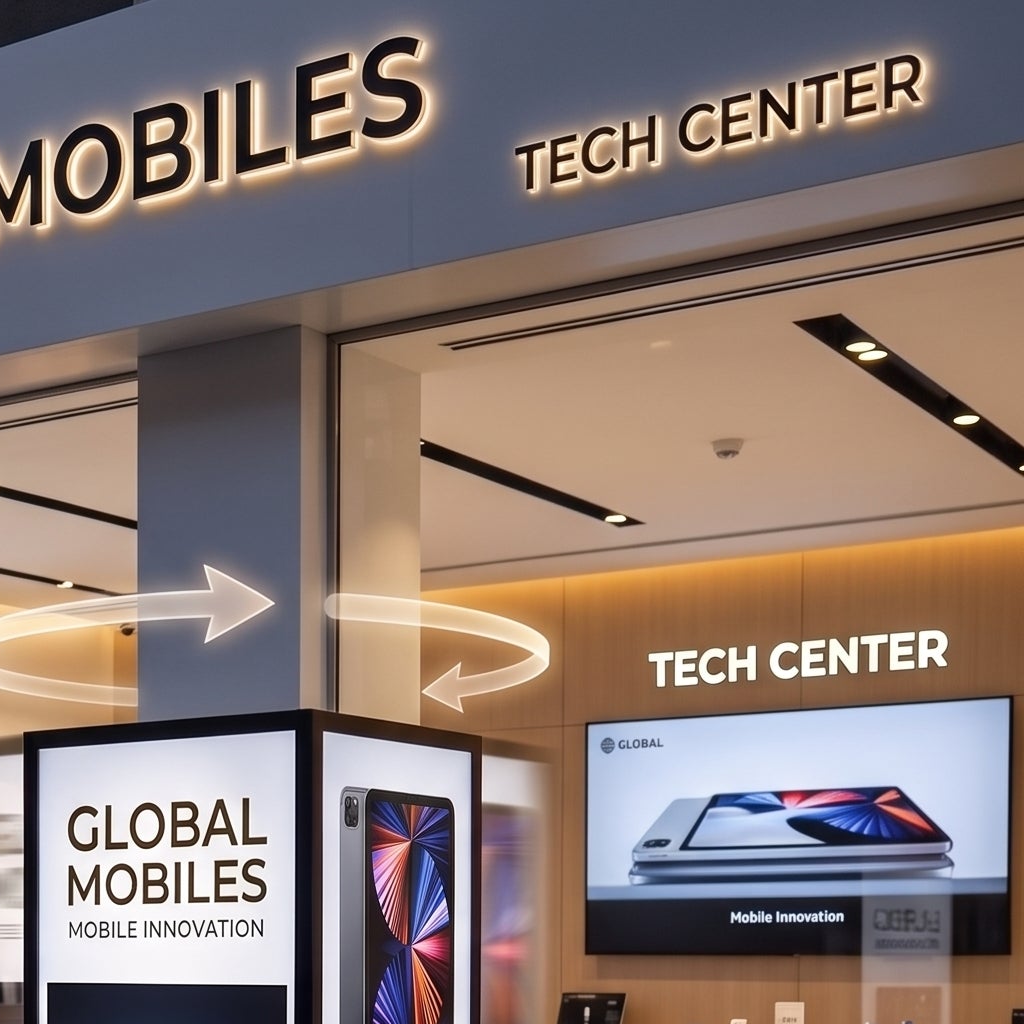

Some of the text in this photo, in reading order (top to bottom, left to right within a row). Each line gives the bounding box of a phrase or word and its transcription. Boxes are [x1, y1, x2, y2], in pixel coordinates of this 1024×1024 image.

[515, 54, 925, 191] TECH CENTER
[648, 629, 950, 688] TECH CENTER
[617, 737, 665, 751] GLOBAL
[67, 797, 268, 852] GLOBAL
[67, 858, 268, 907] MOBILES
[68, 918, 265, 939] MOBILE INNOVATION
[729, 908, 845, 924] Mobile Innovation
